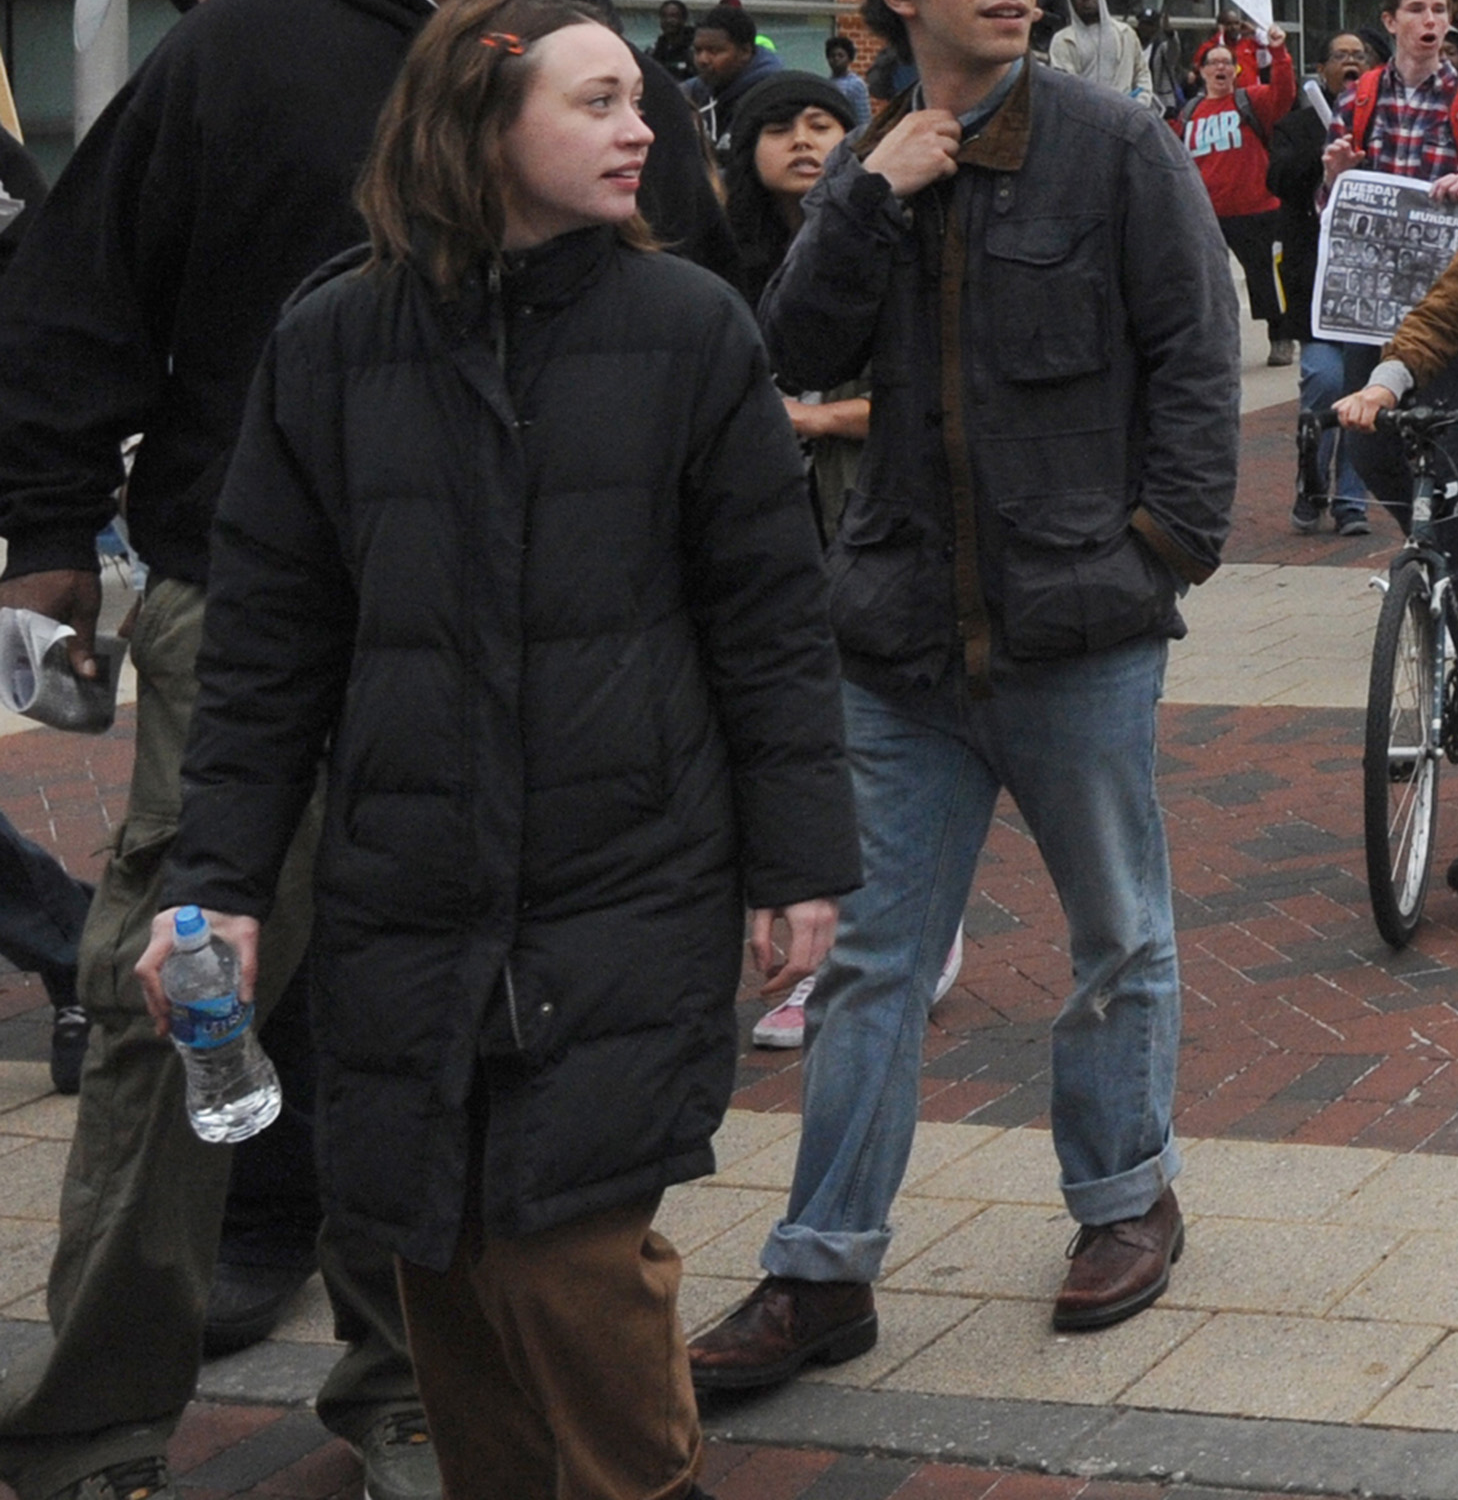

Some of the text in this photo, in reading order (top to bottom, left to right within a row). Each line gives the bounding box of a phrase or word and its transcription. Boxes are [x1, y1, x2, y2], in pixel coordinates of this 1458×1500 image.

[1185, 109, 1242, 158] LIAR
[1342, 181, 1401, 198] TUESDAY
[1338, 191, 1397, 208] APRIL 14
